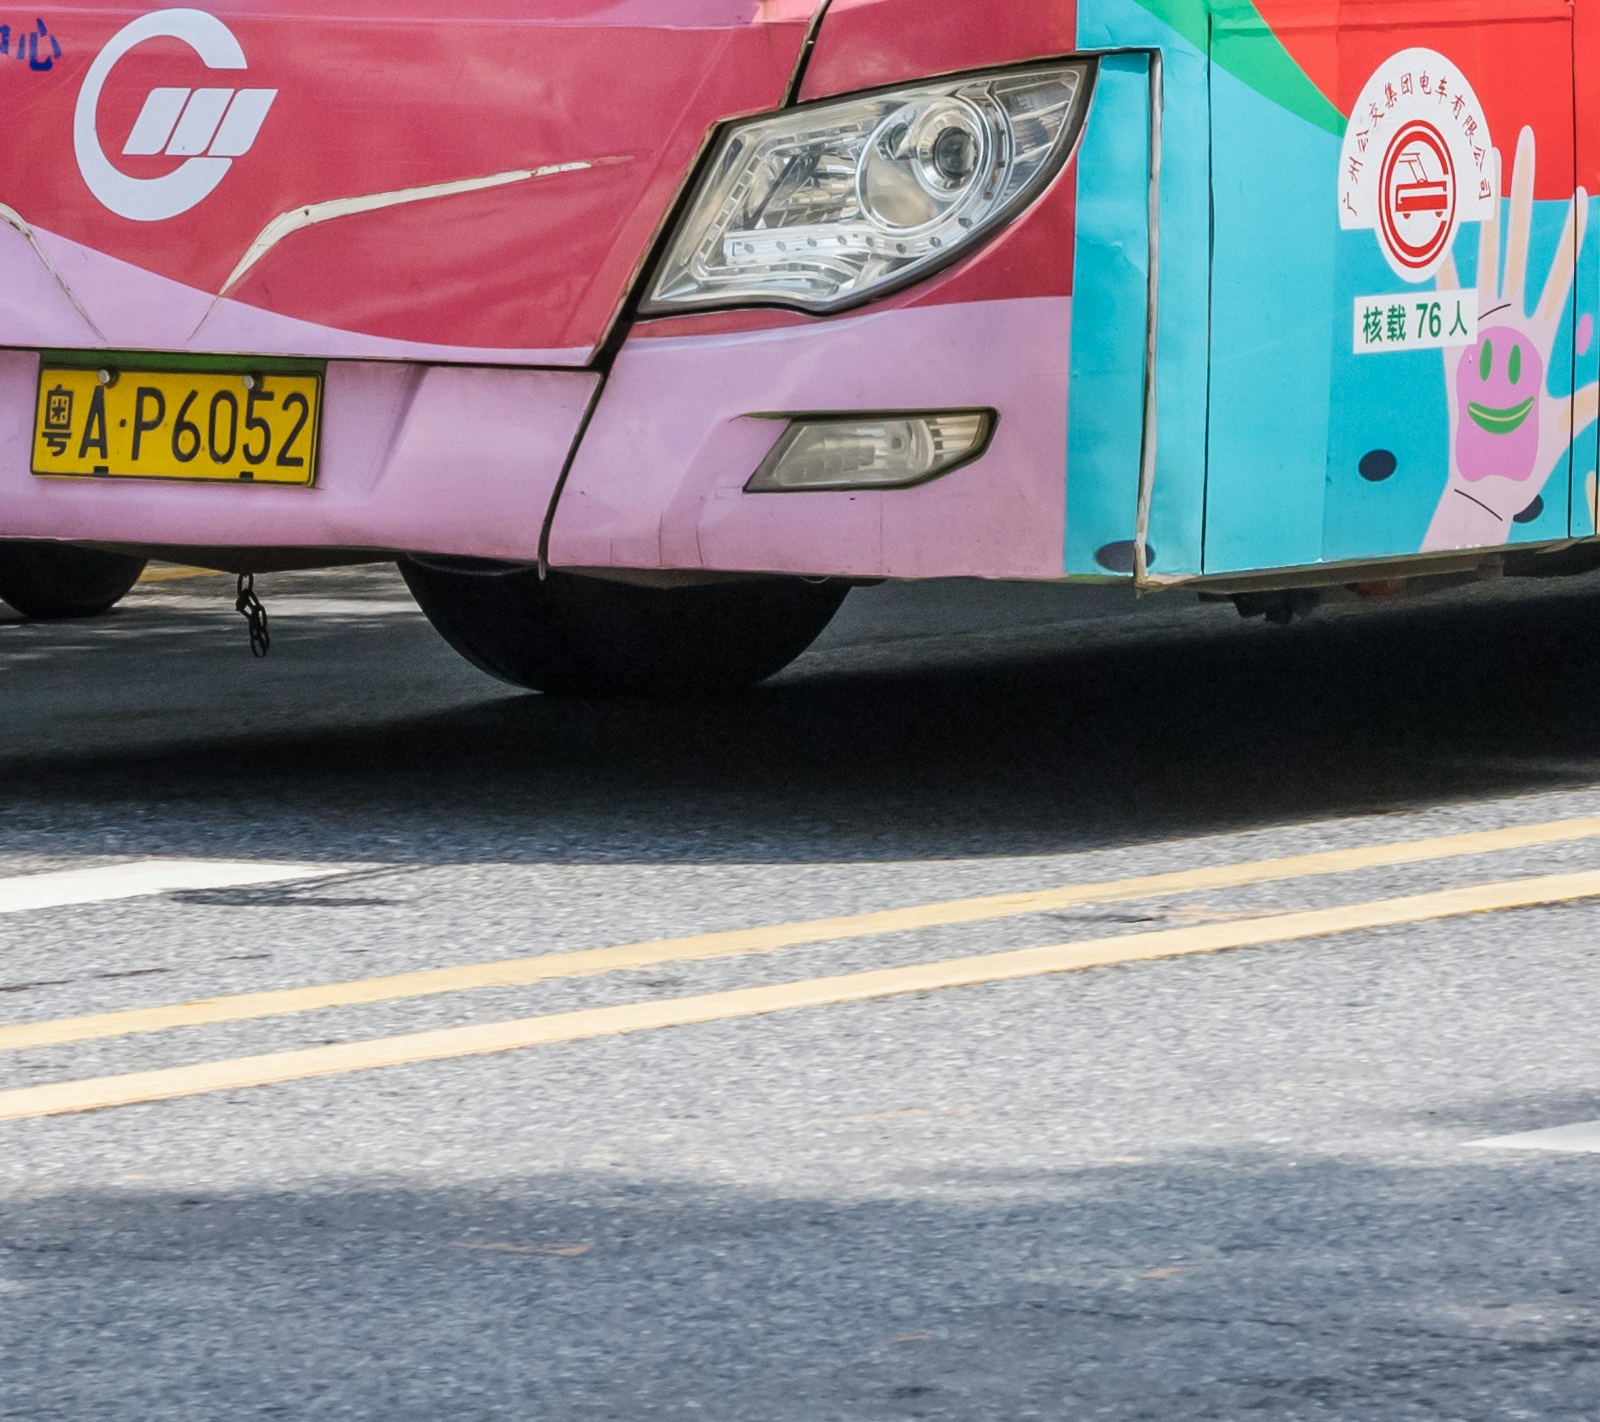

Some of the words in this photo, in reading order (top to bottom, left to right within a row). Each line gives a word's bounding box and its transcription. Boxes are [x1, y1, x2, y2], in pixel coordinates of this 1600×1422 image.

[1343, 70, 1492, 217] 广州公交集团电车有限公司
